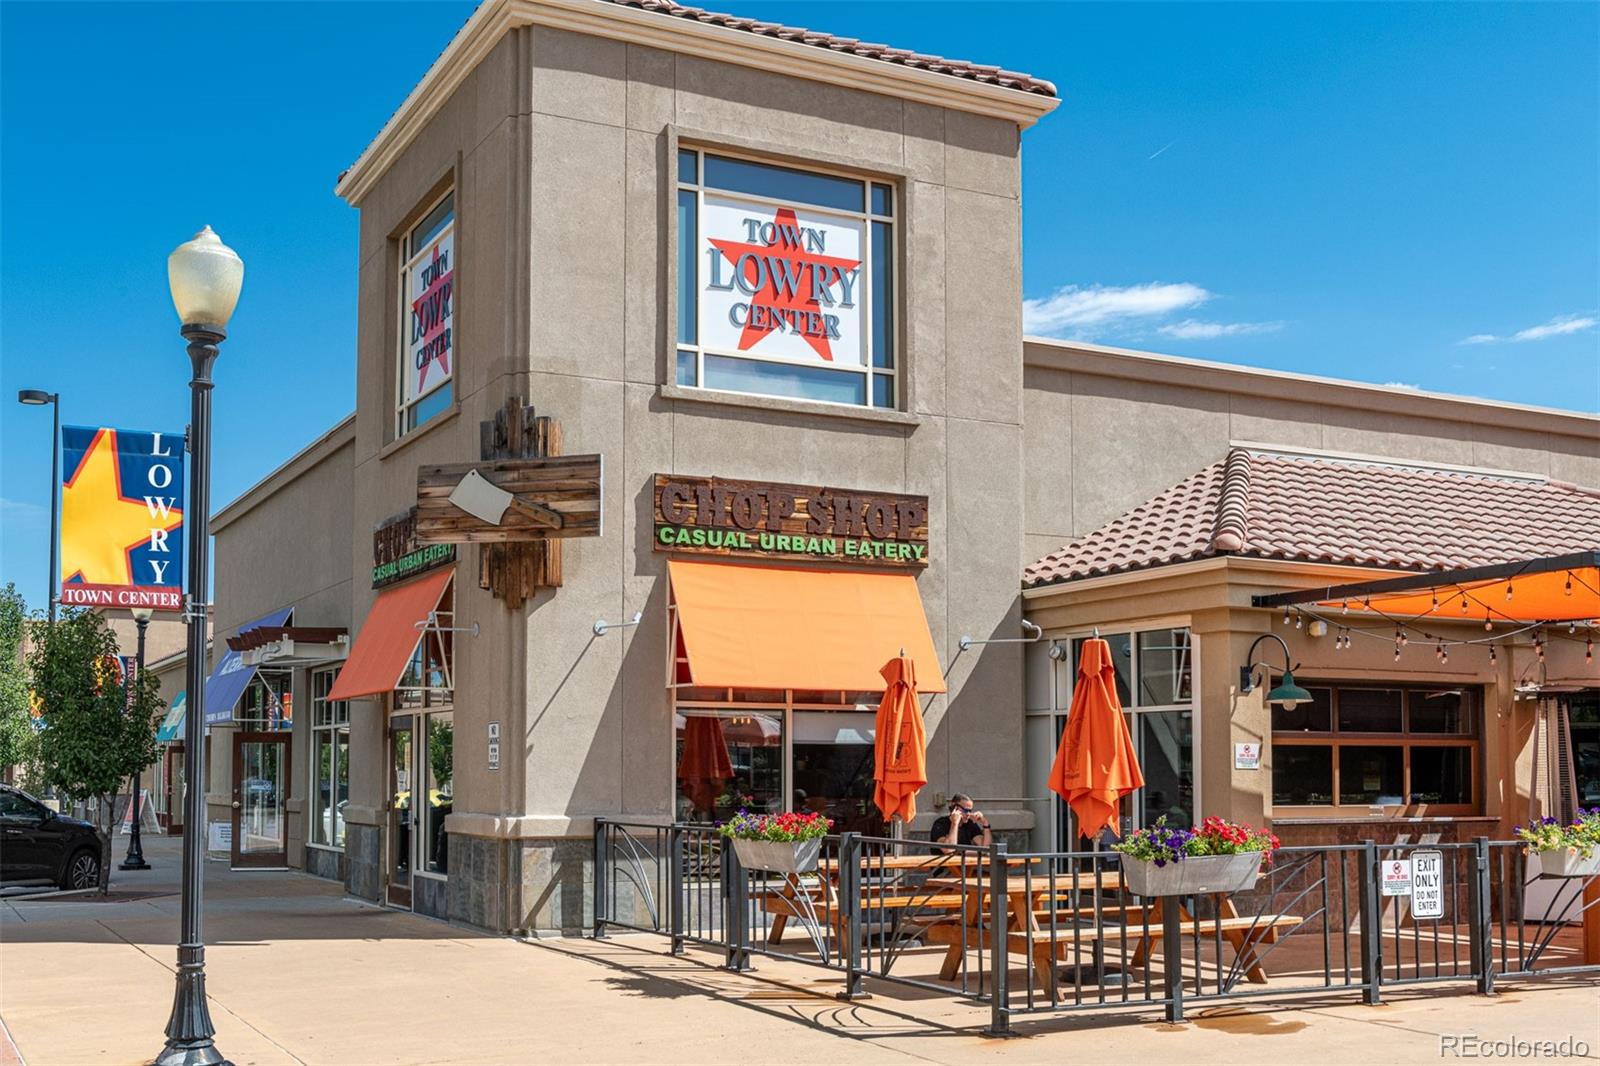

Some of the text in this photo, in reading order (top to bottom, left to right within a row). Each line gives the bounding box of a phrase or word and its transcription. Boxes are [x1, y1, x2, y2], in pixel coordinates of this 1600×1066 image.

[742, 217, 827, 254] TOWN
[421, 250, 449, 291] TOWN
[705, 247, 861, 310] LOWRY
[410, 278, 453, 346] LOWR
[728, 302, 843, 341] CENTER
[415, 327, 452, 370] CENTER
[143, 432, 177, 585] LOWRY
[660, 481, 927, 541] CHOP SHOP
[658, 526, 926, 561] CASUAL URBAN EATERY
[373, 561, 398, 582] CASUAL
[399, 552, 424, 573] URBAN
[64, 589, 181, 607] TOWN CENTER
[1415, 873, 1439, 888] ONLY
[1417, 858, 1436, 872] EXIT
[1416, 890, 1439, 900] DO NOT
[1418, 901, 1438, 911] ENTER
